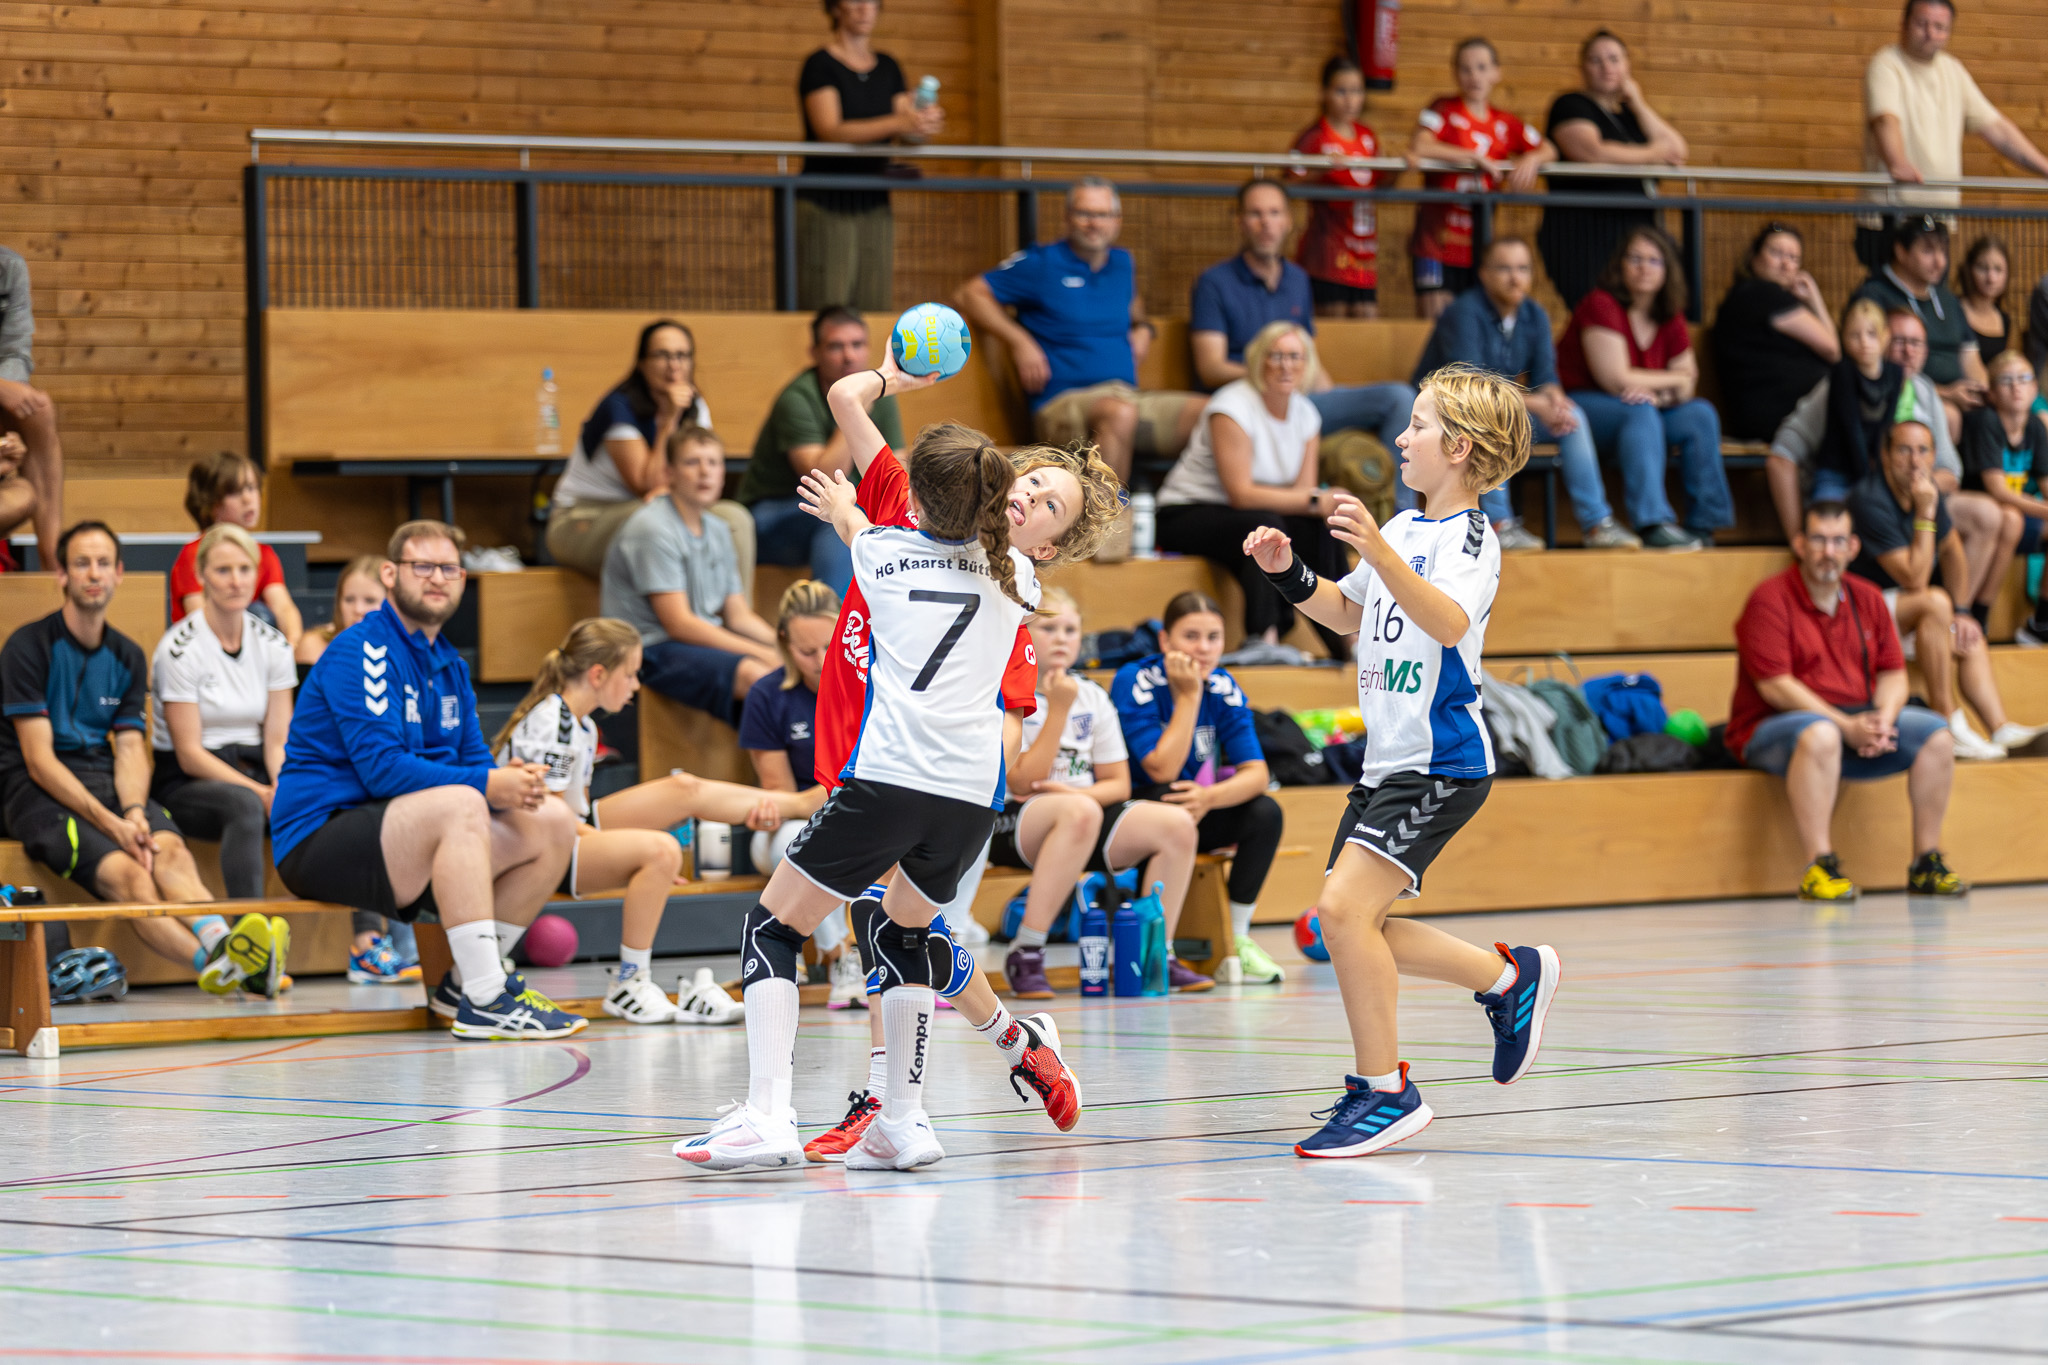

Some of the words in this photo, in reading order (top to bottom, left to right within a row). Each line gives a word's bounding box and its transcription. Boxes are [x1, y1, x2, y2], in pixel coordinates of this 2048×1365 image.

[926, 316, 940, 364] erima
[876, 562, 894, 579] HG
[900, 558, 952, 572] Kaarst
[958, 559, 996, 581] Bütt
[909, 590, 981, 692] 7
[1373, 597, 1404, 643] 16
[1360, 658, 1423, 695] eightMS
[909, 1012, 929, 1085] Kempa
